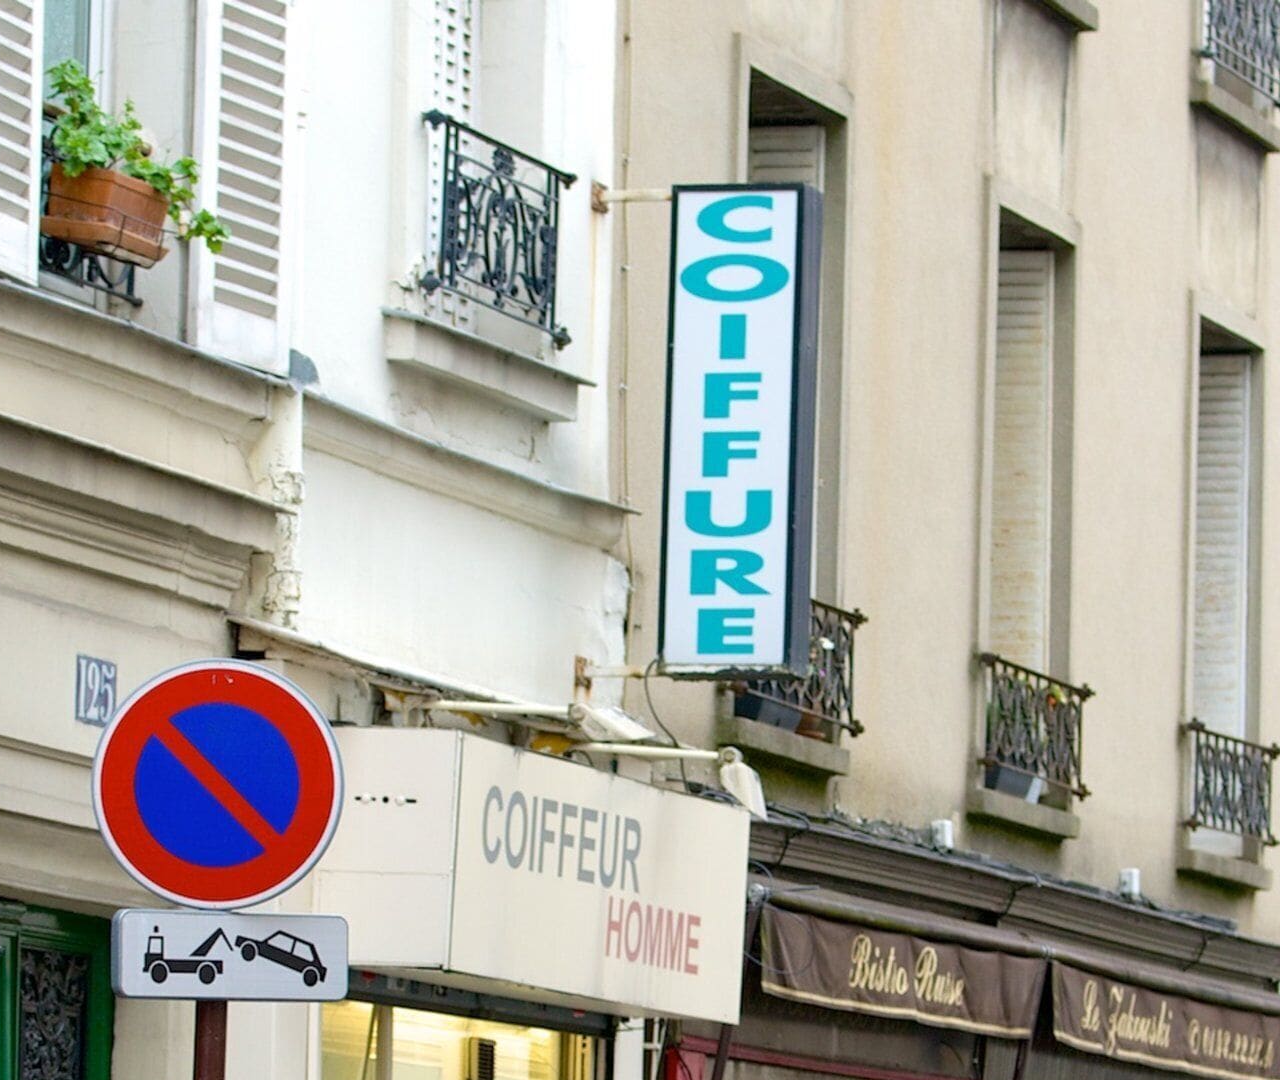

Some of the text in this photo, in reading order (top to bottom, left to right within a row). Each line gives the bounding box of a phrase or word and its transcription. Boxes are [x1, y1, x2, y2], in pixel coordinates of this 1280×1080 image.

[680, 195, 790, 655] COIFFURE
[78, 658, 115, 723] 125
[482, 785, 641, 893] COIFFEUR
[605, 896, 701, 975] HOMME
[849, 934, 909, 995] Bistro
